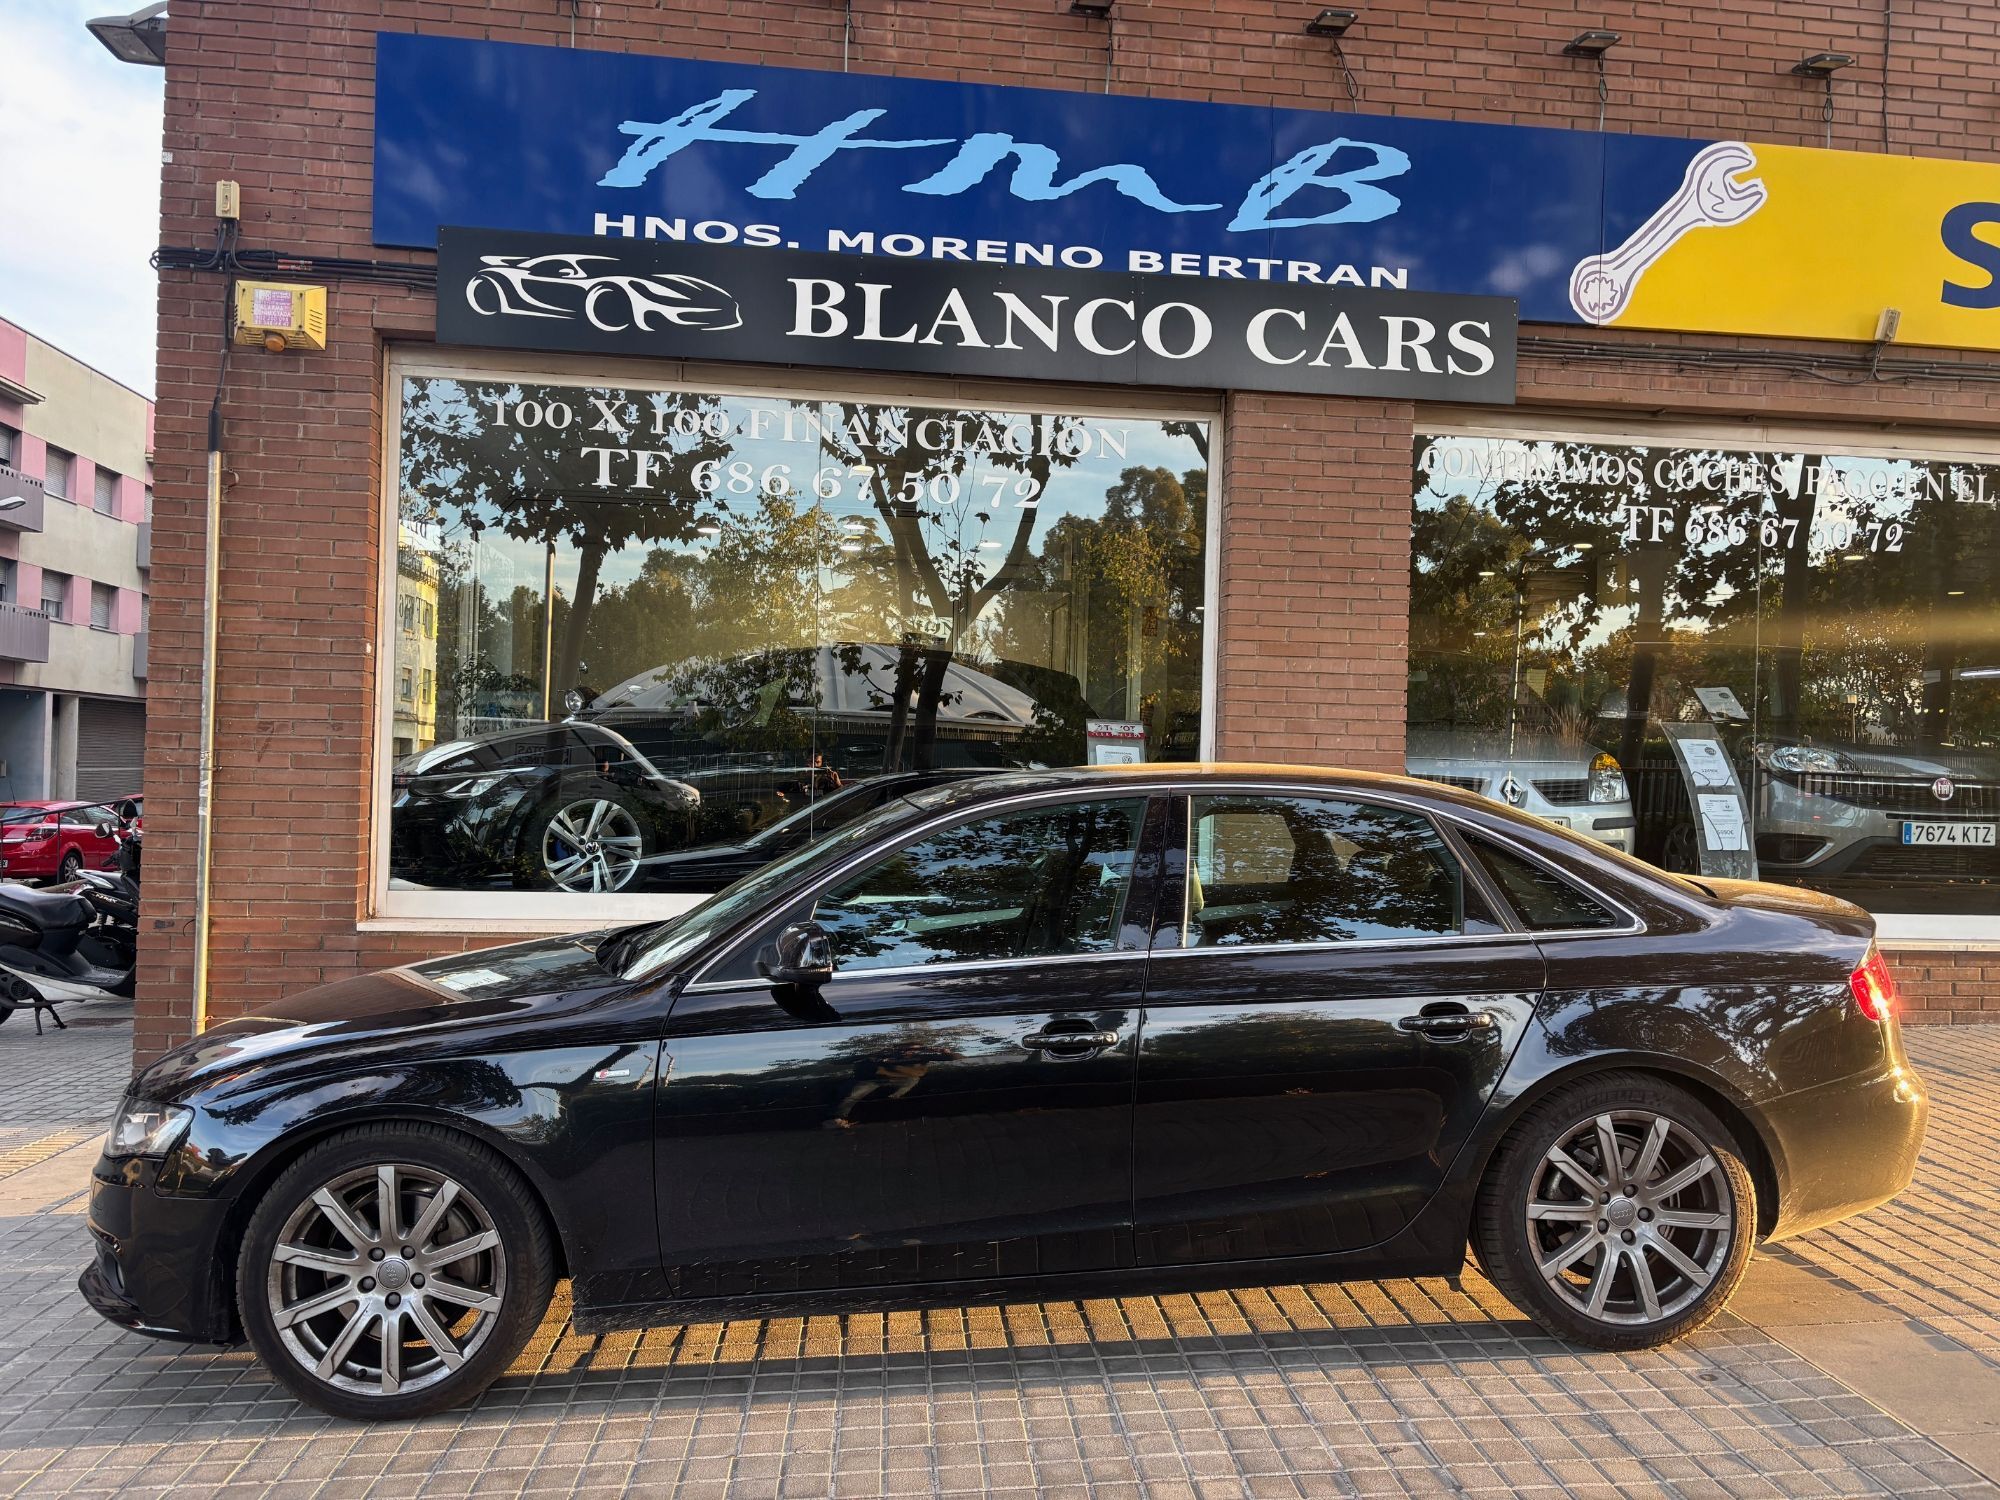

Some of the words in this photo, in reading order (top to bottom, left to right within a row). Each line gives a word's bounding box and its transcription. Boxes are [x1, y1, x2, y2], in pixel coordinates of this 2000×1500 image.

[594, 213, 799, 249] HNOS.
[828, 229, 1103, 269] MORENO
[1129, 250, 1408, 289] BERTRAN
[1941, 202, 2000, 308] S
[786, 278, 1213, 359] BLANCO
[1246, 308, 1495, 376] CARS
[491, 400, 573, 429] 100
[588, 399, 629, 433] X
[651, 408, 730, 438] 100
[746, 408, 1133, 460] FINANCIACIÓN
[581, 447, 672, 489] TF
[690, 460, 791, 496] 686
[811, 465, 876, 501] 67
[896, 469, 961, 505] 50
[981, 473, 1042, 509] 72
[1421, 445, 1644, 487] COMPRAMOS
[1806, 465, 1888, 499] PAGO
[1903, 470, 1950, 502] EN
[1953, 472, 1995, 504] EL
[1621, 504, 1674, 543] TF
[1685, 513, 1748, 548] 686
[1761, 516, 1800, 550] 67
[1865, 521, 1904, 553] 72
[1915, 825, 1957, 843] 7674
[1962, 826, 1991, 843] KTZ
